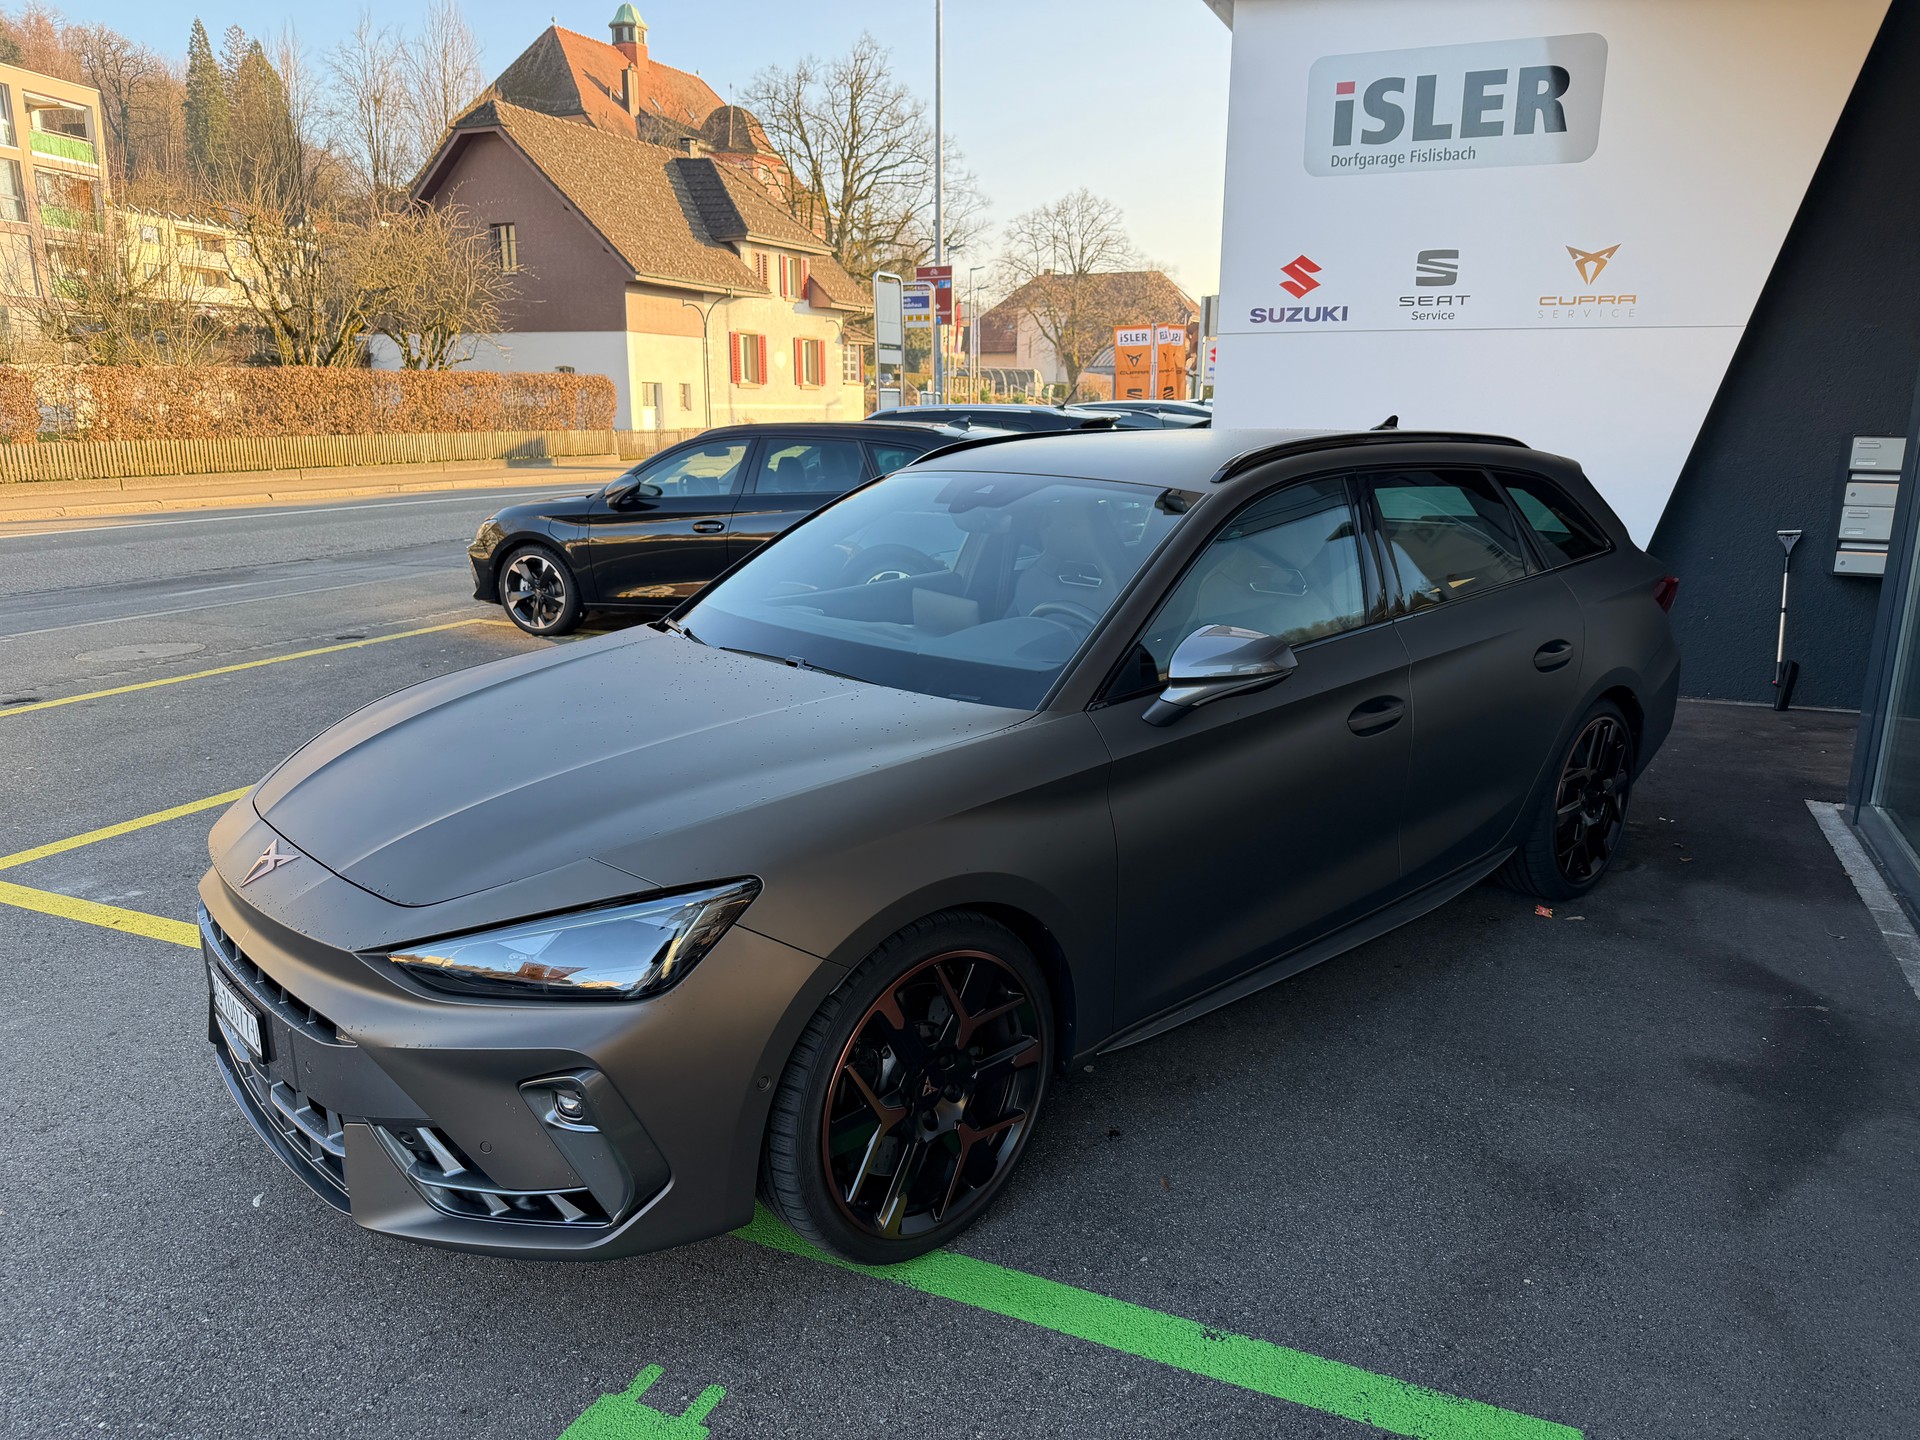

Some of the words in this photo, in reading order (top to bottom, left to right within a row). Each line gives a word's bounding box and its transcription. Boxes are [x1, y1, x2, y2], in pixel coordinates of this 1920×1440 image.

[1330, 152, 1405, 170] Dorfgarage
[1410, 146, 1477, 163] Fislisbach
[1398, 295, 1471, 307] SEAT
[1539, 295, 1637, 306] CUPRA
[1249, 305, 1349, 324] SUZUKI
[1411, 310, 1455, 321] Service
[1537, 308, 1636, 319] SERVICE
